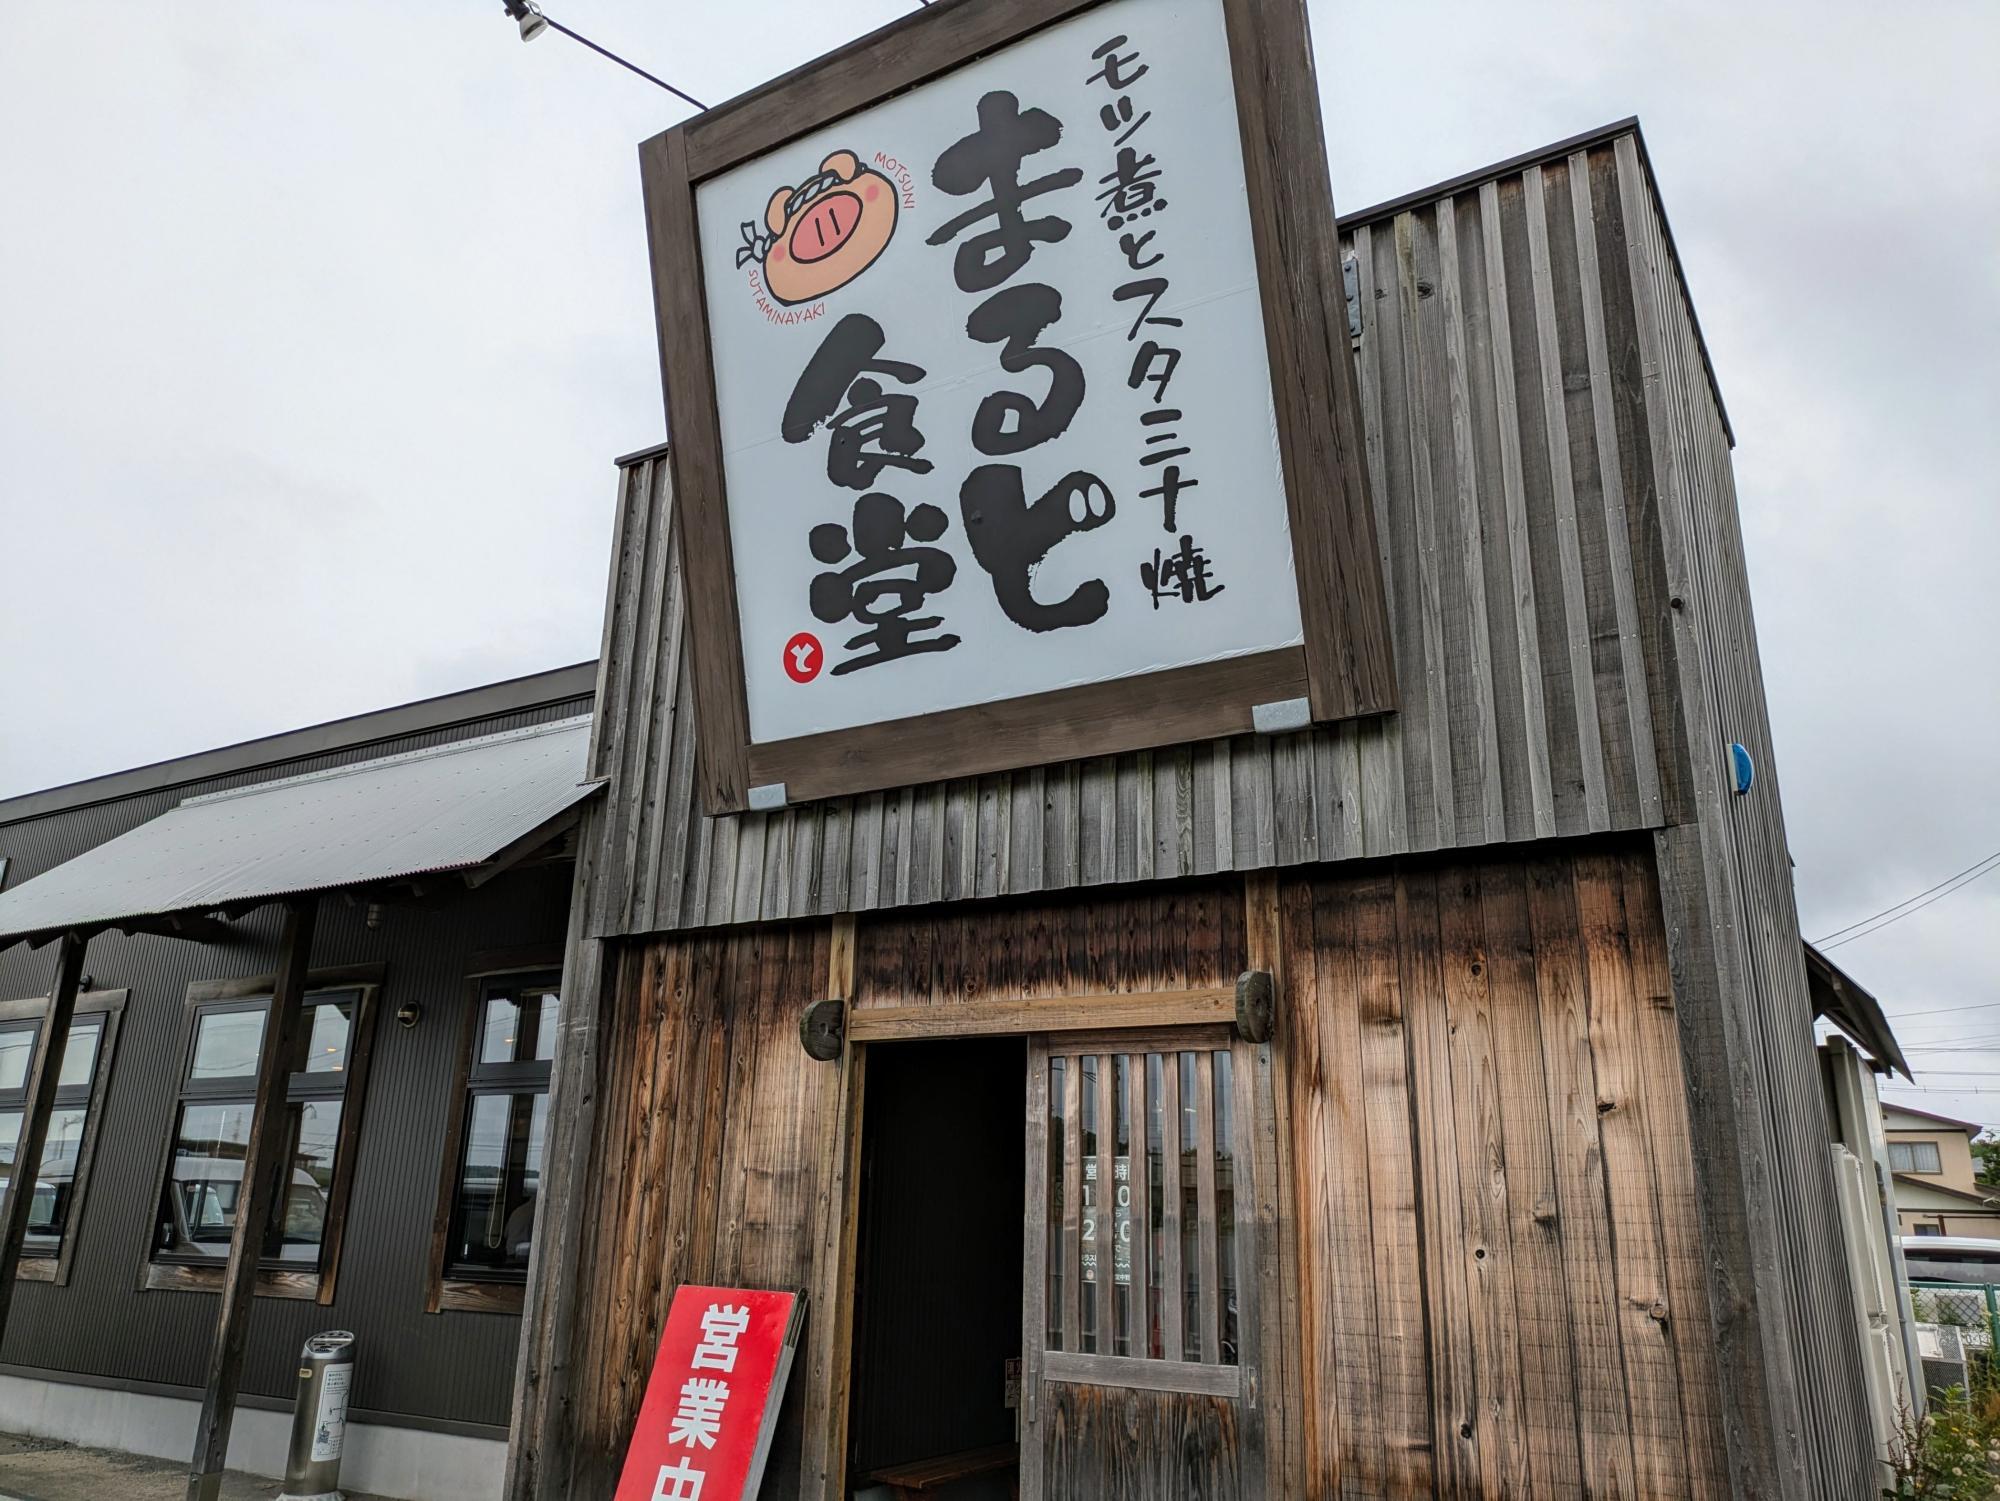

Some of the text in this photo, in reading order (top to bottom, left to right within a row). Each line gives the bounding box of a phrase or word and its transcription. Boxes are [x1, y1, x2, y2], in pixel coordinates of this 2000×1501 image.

[874, 151, 915, 209] MOTSUNI
[748, 269, 826, 325] SUTAMINAYAKI
[782, 313, 963, 677] 食堂
[651, 1303, 750, 1501] 営業中
